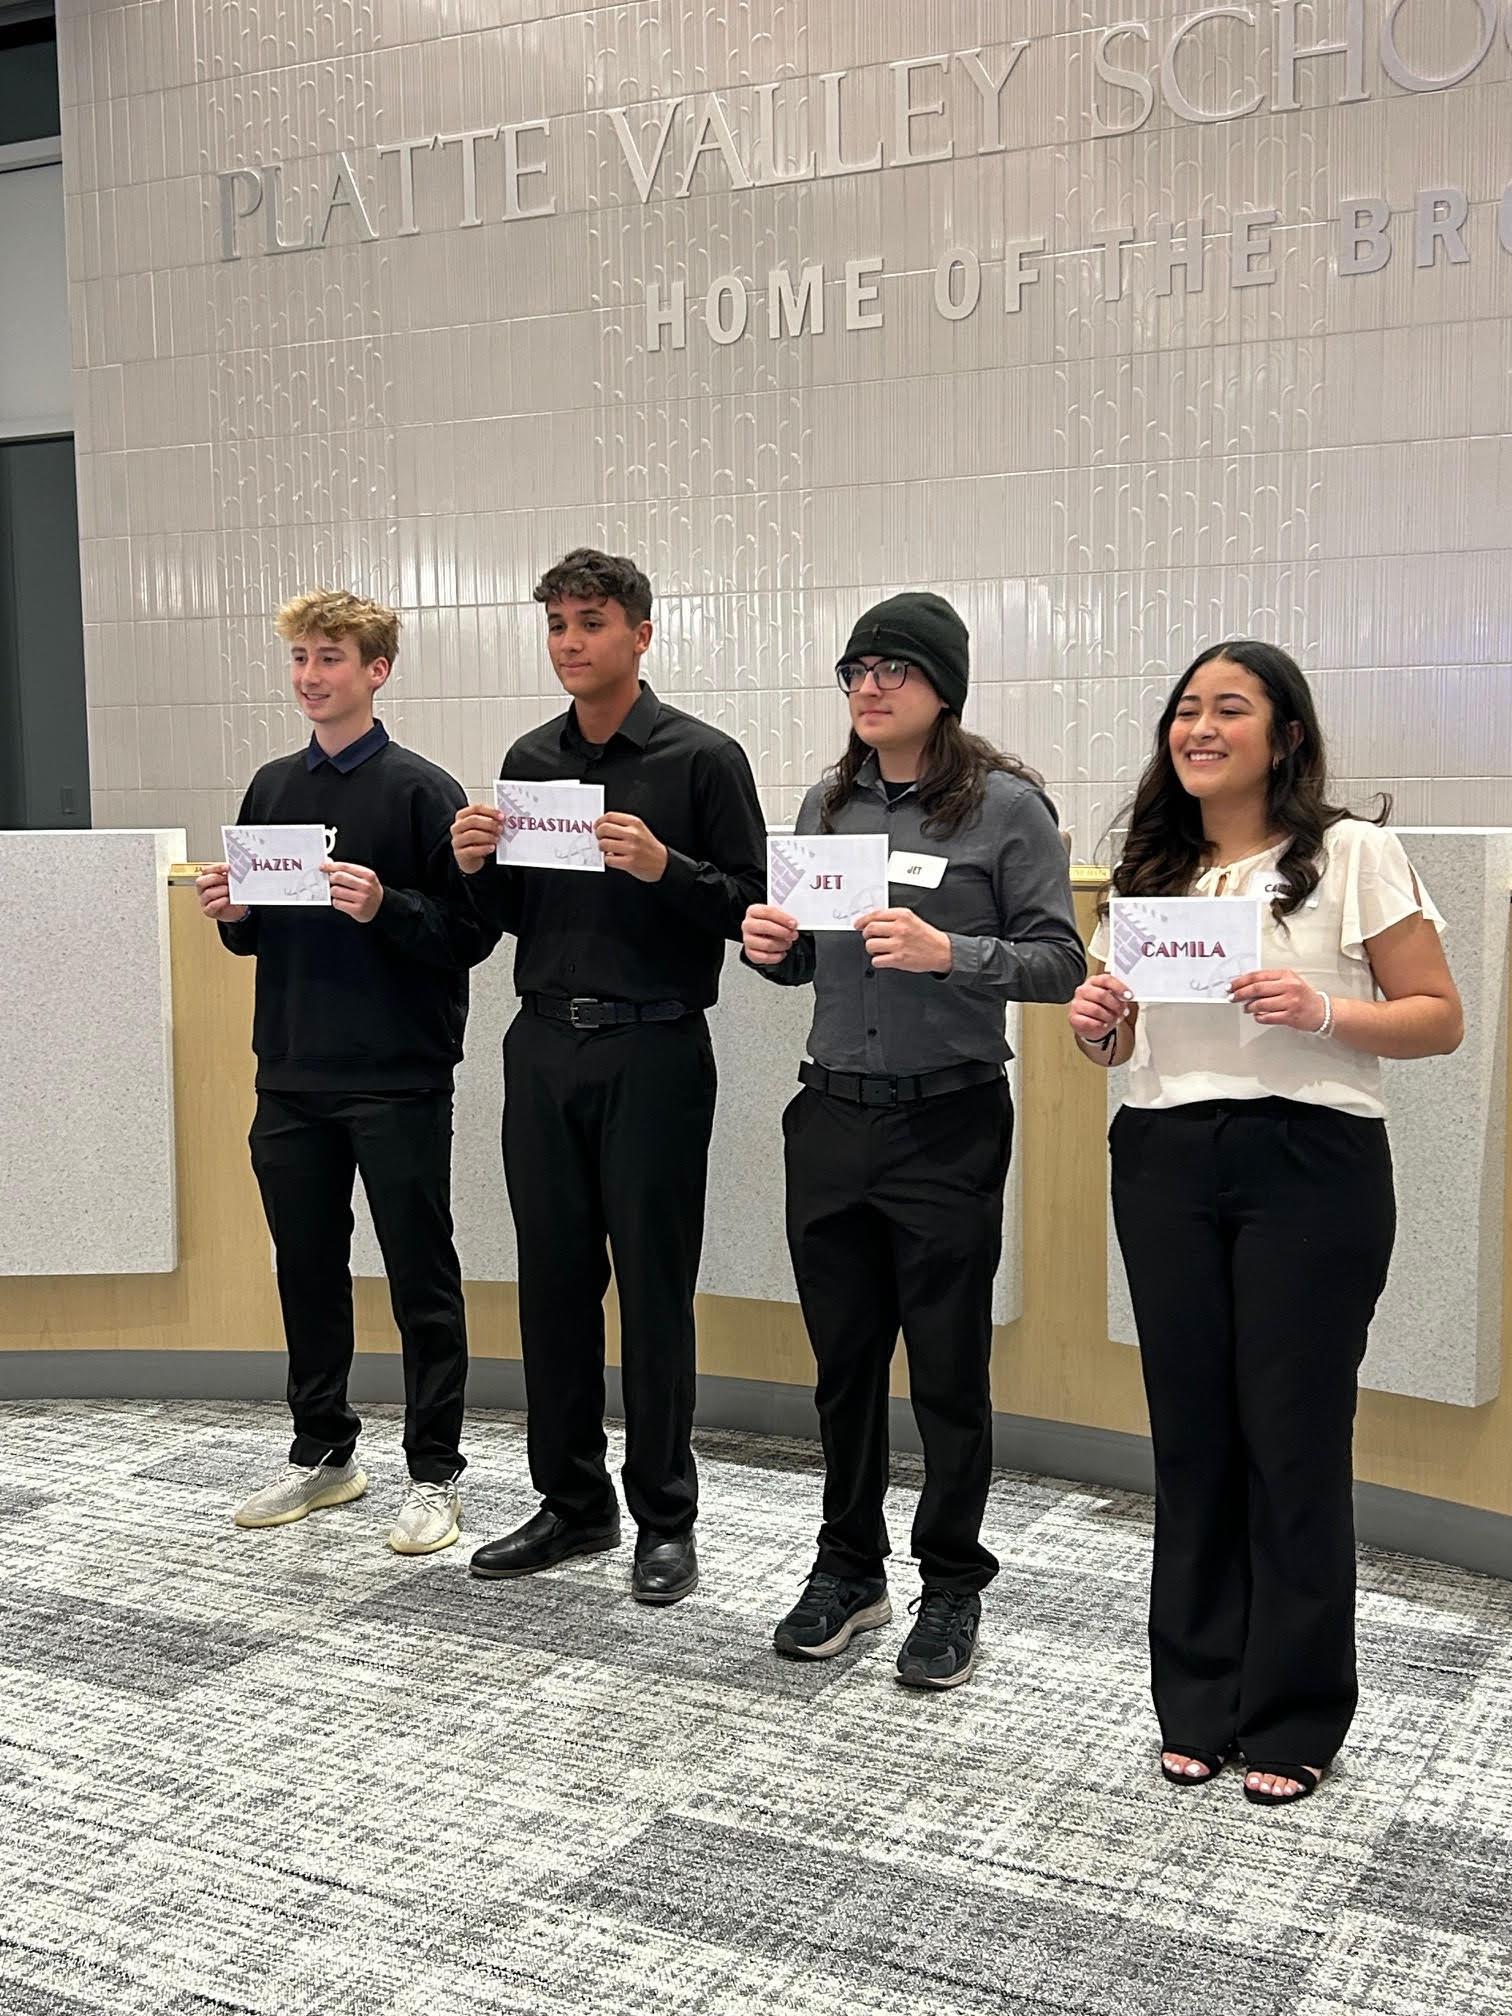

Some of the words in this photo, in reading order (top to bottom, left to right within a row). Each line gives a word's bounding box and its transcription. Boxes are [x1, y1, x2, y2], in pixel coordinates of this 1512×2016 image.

[217, 119, 556, 261] PLATTE
[605, 41, 1031, 203] VALLEY
[1092, 0, 1512, 138] SCHO
[646, 257, 884, 351] HOME
[933, 237, 1045, 320] OF
[1092, 208, 1278, 301] THE
[1338, 178, 1512, 276] BR
[507, 815, 593, 834] SEBASTIAN
[251, 858, 303, 872] HAZEN
[809, 874, 844, 890] JET
[1141, 941, 1226, 958] CAMILA
